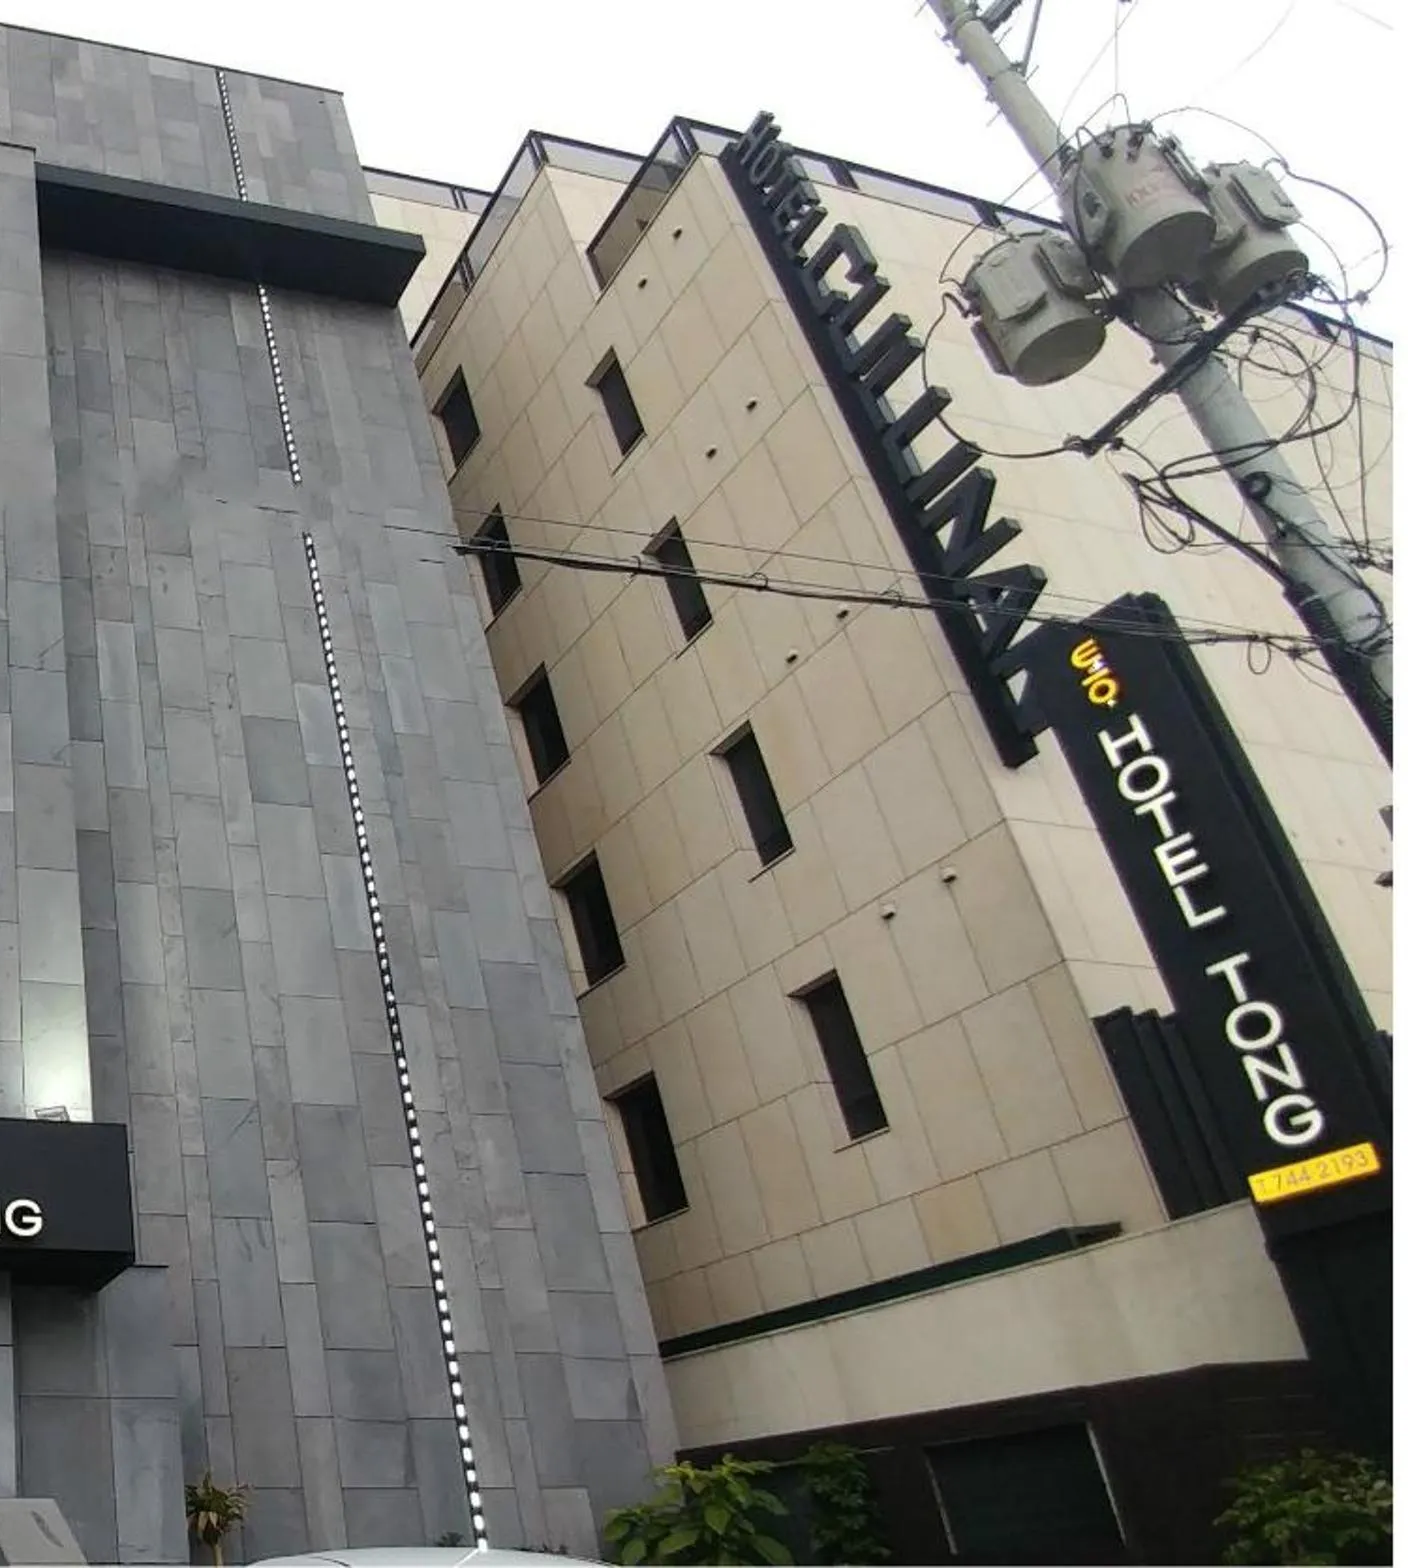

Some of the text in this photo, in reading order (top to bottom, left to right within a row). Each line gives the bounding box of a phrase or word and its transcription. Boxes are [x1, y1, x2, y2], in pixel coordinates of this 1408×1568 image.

[735, 110, 828, 264] HOTEL
[1098, 714, 1325, 1146] HOTEL TONG
[1316, 1149, 1370, 1180] 2193
